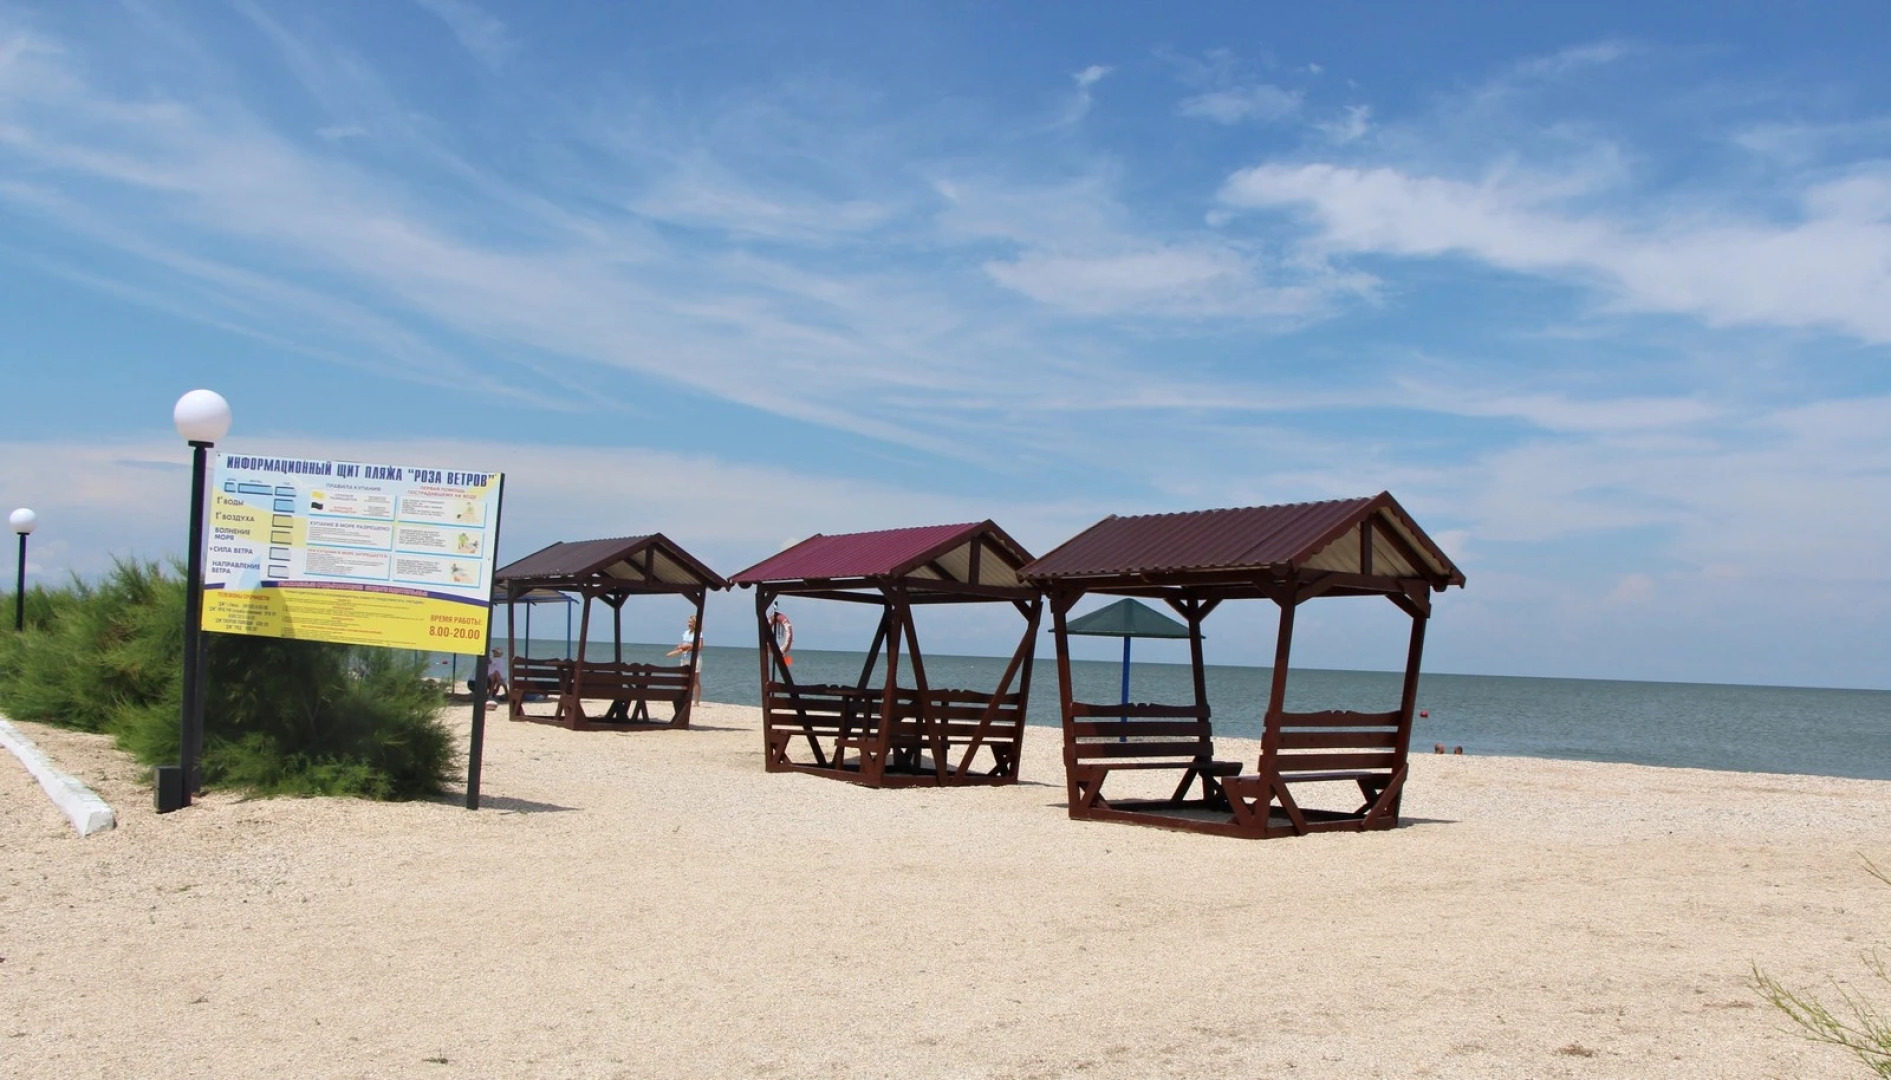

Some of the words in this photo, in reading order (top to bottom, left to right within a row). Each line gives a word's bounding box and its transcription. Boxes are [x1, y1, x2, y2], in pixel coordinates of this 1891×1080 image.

[227, 455, 332, 476] ИНФОРМАЦИОННЫЙ
[337, 463, 360, 478] ЩИТ
[365, 466, 402, 481] ПЛЯЖА
[223, 498, 245, 506] ВОДЫ
[222, 514, 255, 522] ВОЗДУХА
[214, 527, 251, 535] ВОЛНЕНИЕ
[212, 561, 260, 570] НАПРАВЛЕНИЕ
[430, 614, 453, 623] ВРЕМЯ
[429, 625, 480, 640] 8.00-20.00
